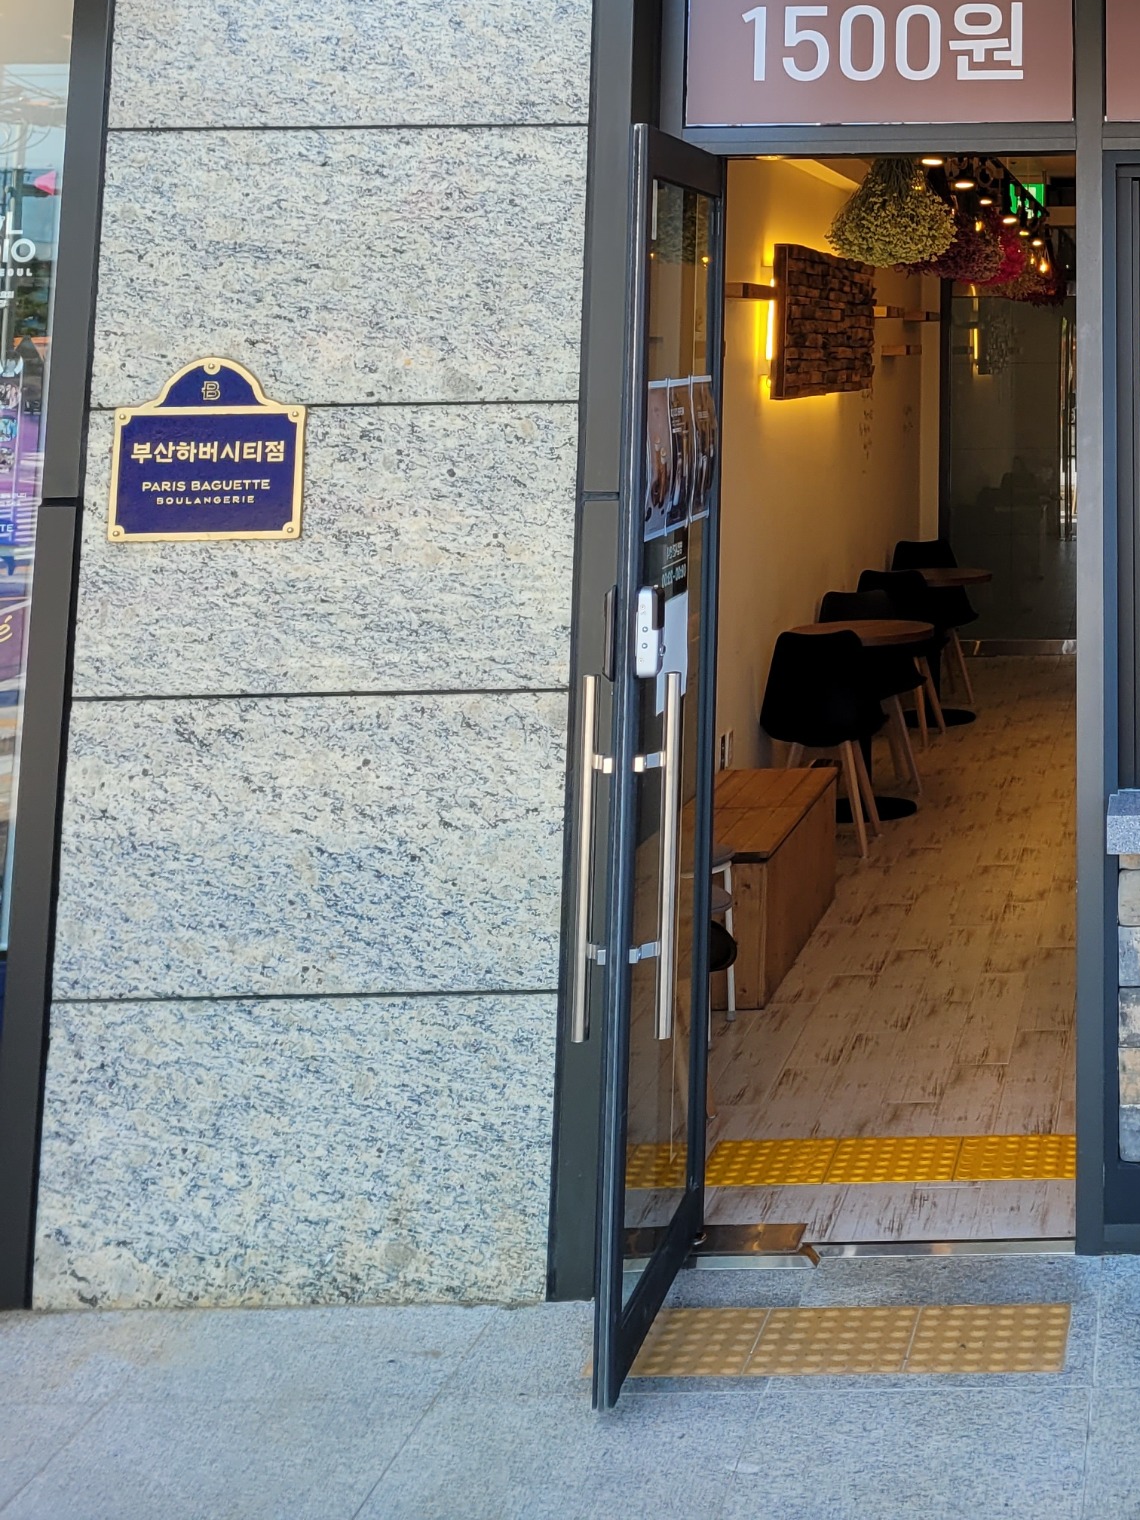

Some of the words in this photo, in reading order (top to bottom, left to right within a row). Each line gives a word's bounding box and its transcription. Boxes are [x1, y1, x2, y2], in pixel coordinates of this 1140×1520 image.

[741, 1, 1024, 81] 1500원
[131, 440, 285, 464] 부산하버시티점
[142, 481, 186, 492] PARIS
[191, 479, 270, 491] BAGUETTE
[156, 495, 255, 505] BOULANGERIE
